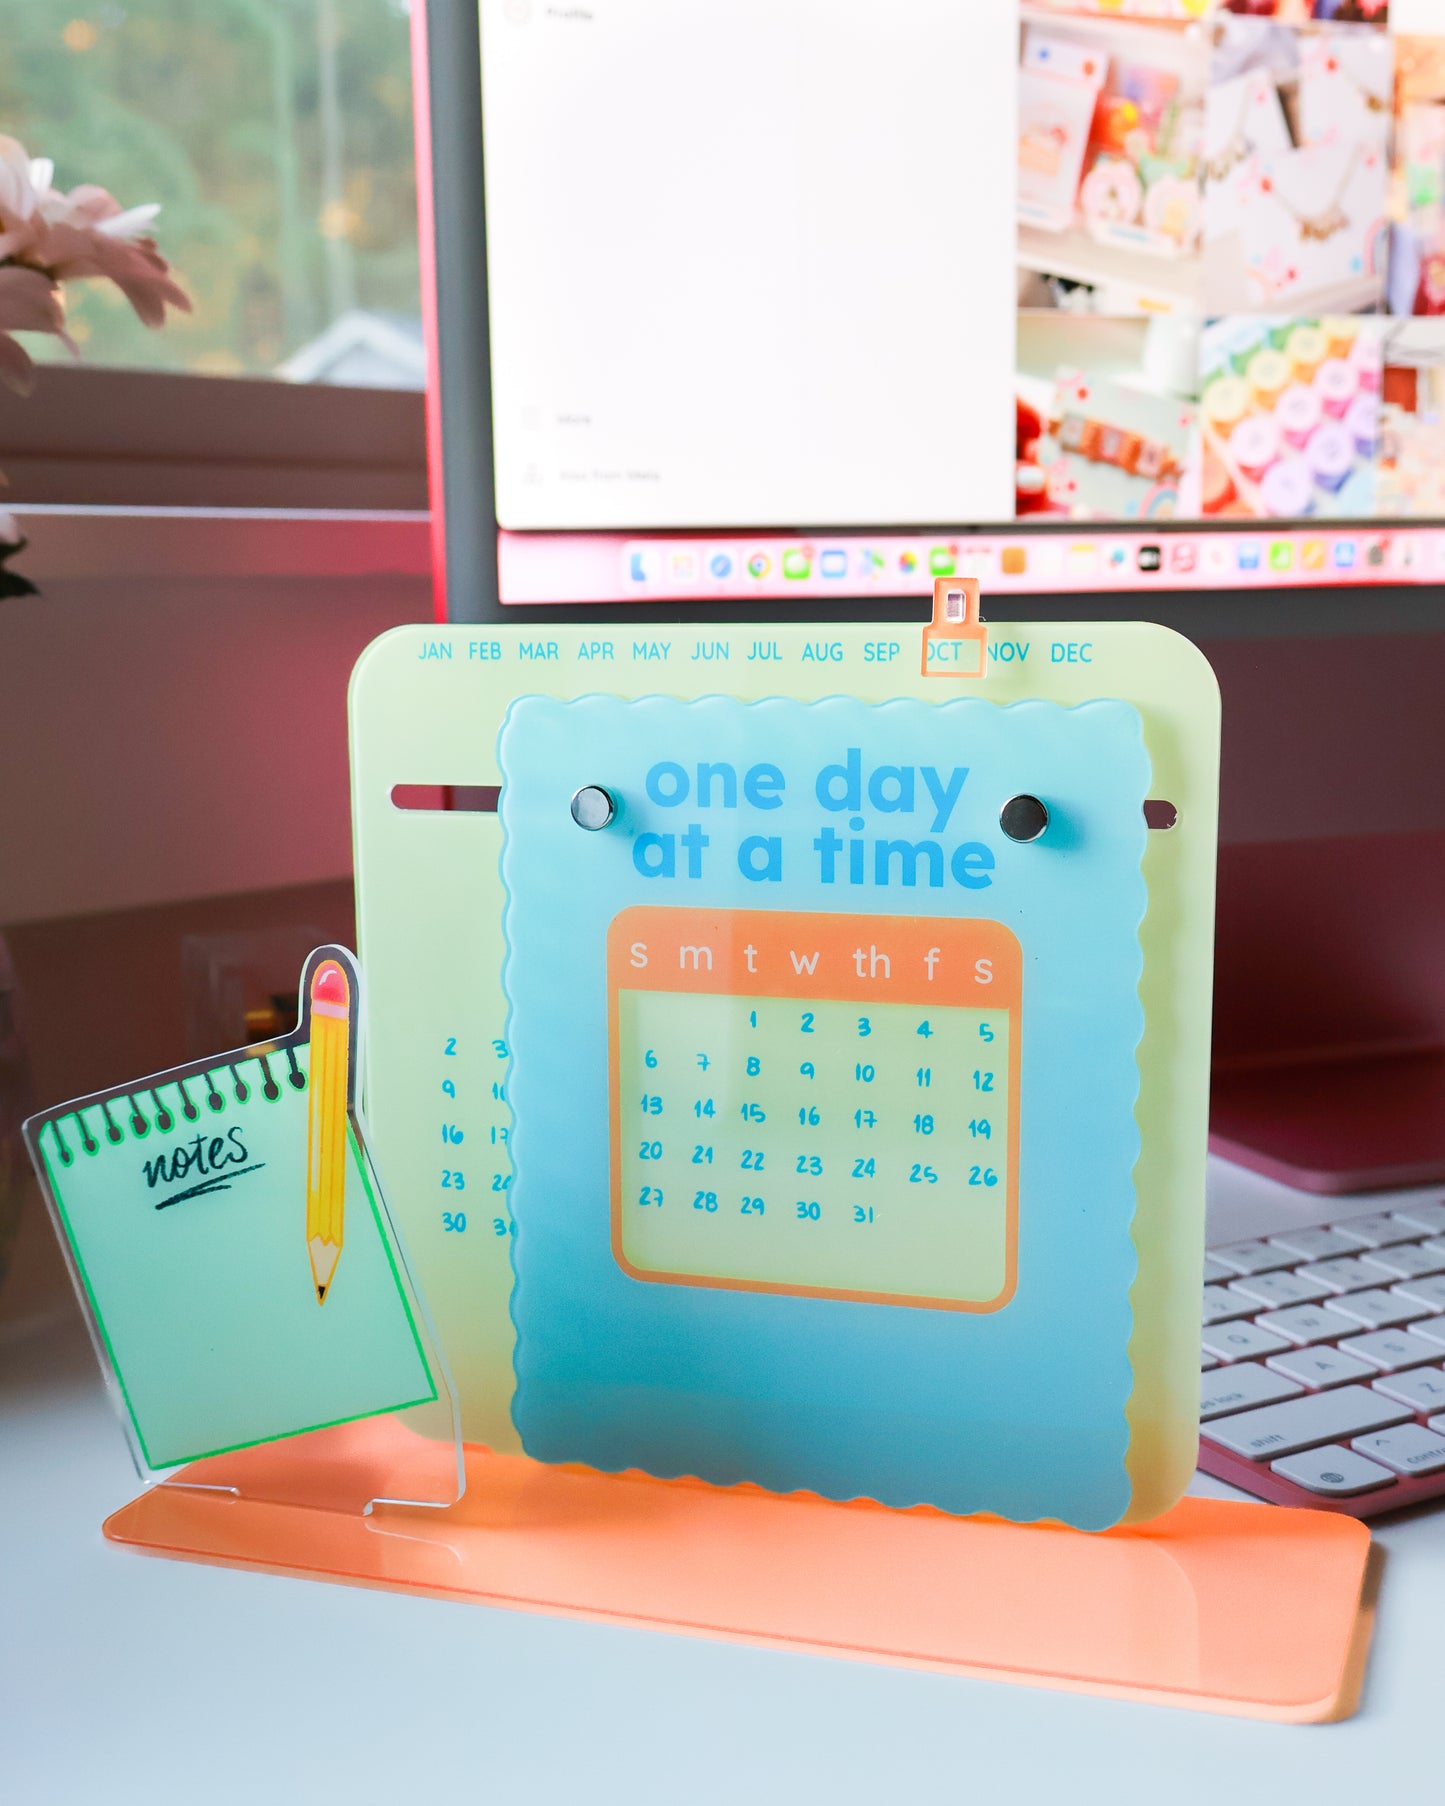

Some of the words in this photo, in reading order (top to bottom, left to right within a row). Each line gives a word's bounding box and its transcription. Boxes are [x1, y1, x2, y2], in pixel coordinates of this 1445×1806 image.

[418, 642, 452, 660] JAN
[469, 641, 502, 661] FEB
[519, 641, 558, 660] MAR
[578, 641, 614, 660] APR
[633, 642, 671, 660] MAY
[691, 641, 729, 661] JUN
[747, 642, 783, 661] JUL
[802, 642, 843, 662] AUG
[864, 642, 900, 662] SEP
[1051, 642, 1092, 663] DEC
[644, 761, 786, 812] one
[814, 748, 970, 834] day
[632, 820, 709, 878] at
[738, 835, 782, 882] a
[813, 817, 996, 889] time
[630, 942, 648, 968] s
[680, 946, 712, 970] m
[744, 944, 757, 973] t
[790, 951, 819, 975] w
[852, 945, 890, 978] th
[924, 947, 940, 980] f
[974, 958, 993, 984] s
[750, 1010, 757, 1028] 1
[800, 1012, 814, 1033] 2
[858, 1017, 872, 1037] 3
[916, 1020, 933, 1039] 4
[979, 1023, 994, 1043] 5
[444, 1037, 457, 1056] 2
[492, 1040, 509, 1059] 3
[645, 1049, 658, 1069] 6
[697, 1053, 710, 1072] 7
[746, 1056, 760, 1077] 8
[800, 1062, 815, 1079] 9
[855, 1063, 875, 1083] 10
[916, 1068, 931, 1087] 11
[973, 1070, 994, 1092] 12
[442, 1079, 456, 1099] 9
[442, 1124, 464, 1145] 16
[641, 1094, 663, 1115] 13
[694, 1098, 716, 1118] 14
[740, 1103, 766, 1123] 15
[799, 1106, 820, 1126] 16
[854, 1109, 878, 1129] 17
[913, 1114, 934, 1135] 18
[968, 1119, 991, 1140] 19
[143, 1126, 248, 1188] notes
[639, 1140, 663, 1160] 20
[691, 1144, 713, 1164] 21
[740, 1149, 764, 1171] 22
[796, 1155, 823, 1176] 23
[851, 1157, 875, 1178] 24
[909, 1163, 938, 1184] 25
[968, 1165, 998, 1187] 26
[441, 1170, 465, 1190] 23
[442, 1212, 466, 1233] 30
[639, 1186, 664, 1207] 27
[693, 1190, 718, 1213] 28
[740, 1196, 765, 1216] 29
[796, 1201, 821, 1221] 30
[853, 1205, 874, 1224] 31
[1406, 1447, 1445, 1464] contr
